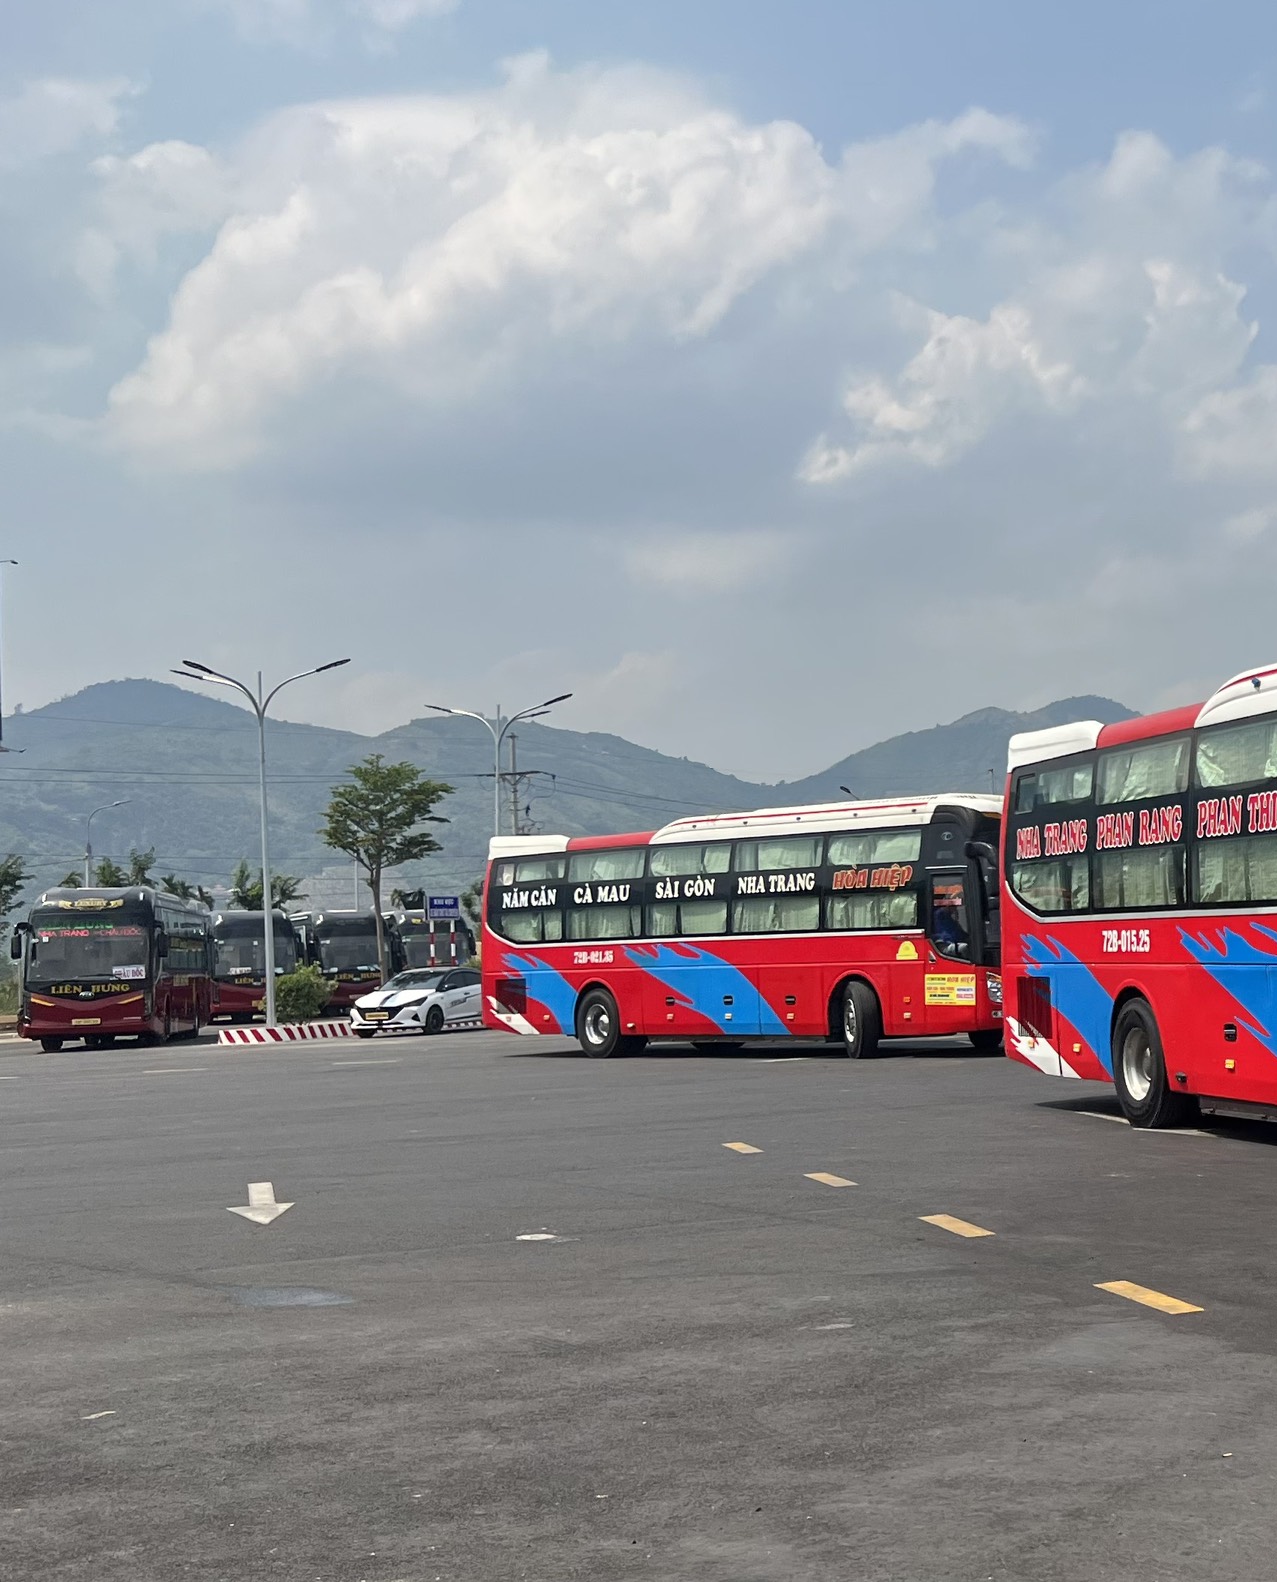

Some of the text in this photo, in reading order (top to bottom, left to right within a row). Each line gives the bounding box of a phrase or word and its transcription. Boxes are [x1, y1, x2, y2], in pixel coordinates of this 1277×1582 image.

[1096, 805, 1183, 849] PHAN RANG
[1197, 796, 1243, 838] PHAN
[1016, 819, 1088, 860] NHA TRANG
[655, 875, 716, 899] SÀI GÒN
[737, 872, 816, 895] NHA TRANG
[832, 862, 913, 892] HÒA HIỆP
[502, 885, 557, 909] NĂM CĂN
[573, 883, 631, 904] CÀ MAU
[1102, 929, 1150, 953] 72B-015.25
[51, 983, 82, 994] LIÊN
